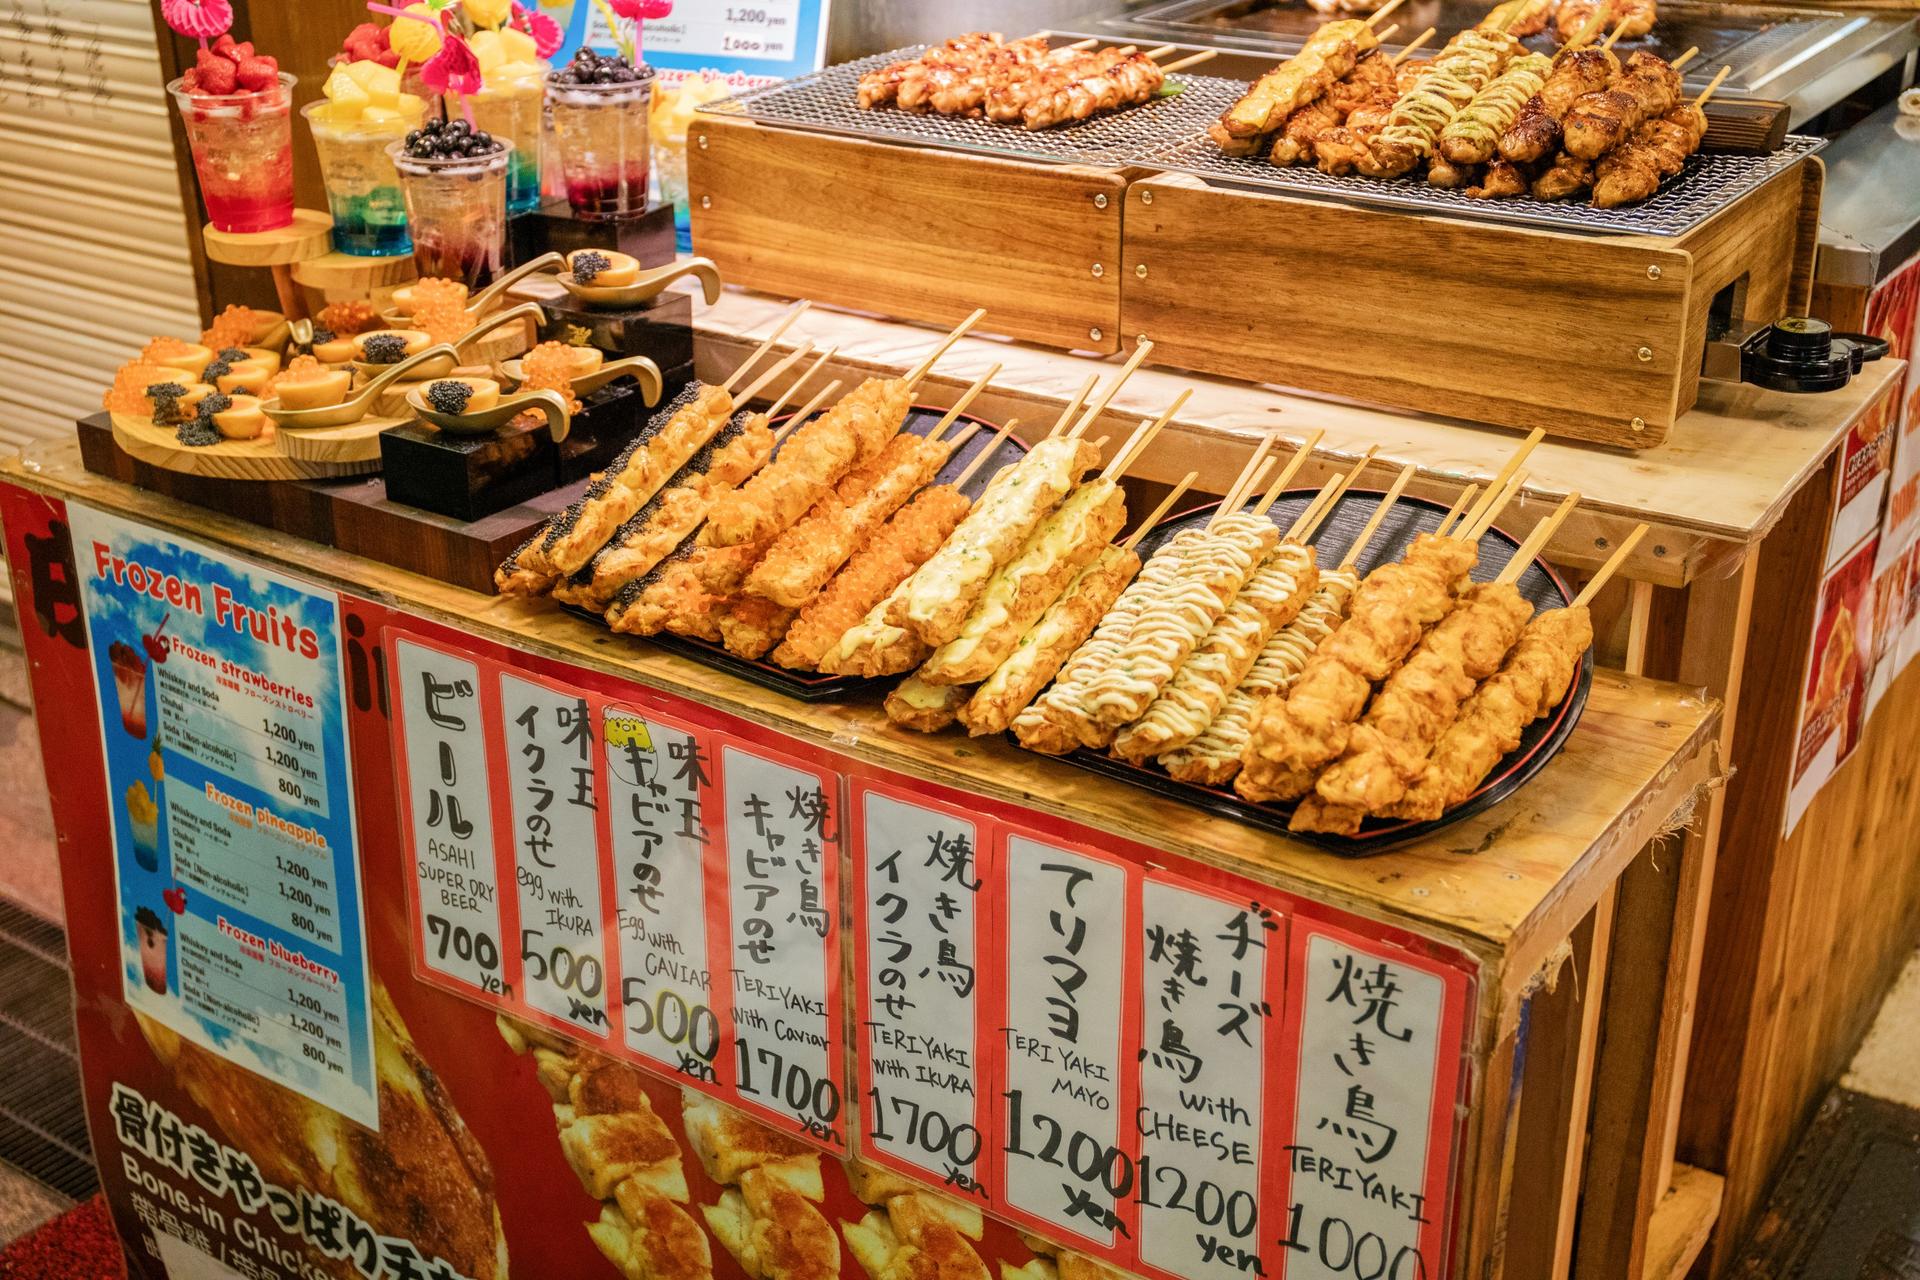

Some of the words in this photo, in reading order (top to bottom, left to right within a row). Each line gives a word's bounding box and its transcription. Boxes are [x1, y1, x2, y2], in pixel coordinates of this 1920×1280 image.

[726, 8, 766, 25] 1,200
[92, 540, 203, 615] Frozen
[214, 585, 320, 660] Fruits
[158, 667, 187, 690] Whiskey
[188, 678, 201, 693] and
[202, 685, 220, 702] Soda
[172, 636, 217, 669] Frozen
[221, 660, 314, 709] strawberries
[163, 721, 180, 738] Soda
[263, 718, 297, 744] 1,200
[298, 736, 315, 753] yen
[422, 671, 474, 840] ビール
[556, 698, 599, 811] 味玉
[265, 746, 299, 773] 1,200
[300, 764, 317, 781] yen
[515, 705, 556, 868] イクラのせ
[668, 736, 711, 845] 味玉
[205, 782, 253, 817] Frozen
[256, 809, 327, 850] pineapple
[278, 778, 302, 800] 800
[303, 792, 320, 809] yen
[428, 838, 475, 870] ASAHI
[624, 737, 670, 915] キャビアのせ
[276, 856, 310, 881] 1,200
[311, 874, 328, 890] yen
[418, 861, 466, 891] SUPER
[470, 878, 494, 903] DRY
[517, 866, 544, 901] egg
[548, 887, 583, 908] with
[738, 793, 787, 966] キャビアのせ
[785, 785, 838, 938] 焼き鳥
[278, 882, 312, 908] 1,200
[314, 902, 331, 917] yen
[291, 912, 315, 934] 800
[316, 928, 333, 943] yen
[441, 889, 482, 913] BEER
[546, 908, 594, 936] IKURA
[616, 908, 645, 942] Egg
[918, 829, 983, 999] 焼き鳥
[218, 917, 265, 951] Frozen
[269, 939, 339, 983] blueberry
[427, 914, 499, 971] 700
[480, 971, 514, 1000] yen
[874, 849, 917, 1020] イクラのせ
[1040, 862, 1094, 1044] てりマヨ
[521, 929, 603, 998] 500
[567, 995, 614, 1029] yen
[644, 952, 713, 992] CAVIAR
[729, 968, 829, 1017] TERIYAKI
[287, 988, 321, 1014] 1,200
[323, 1008, 340, 1023] yen
[290, 1014, 324, 1040] 1,200
[325, 1033, 342, 1048] yen
[622, 977, 720, 1063] 500
[675, 1049, 723, 1087] yen
[1138, 924, 1208, 1084] 焼き鳥
[302, 1042, 326, 1064] 800
[327, 1060, 344, 1075] yen
[774, 1020, 832, 1051] Caviar
[863, 1021, 971, 1069] TERIYAKI
[1316, 954, 1413, 1164] 焼き鳥
[733, 1036, 841, 1125] 1700
[797, 1112, 846, 1148] yen
[915, 1065, 975, 1098] IKURA
[1051, 1076, 1110, 1111] MAYO
[1179, 1089, 1252, 1127] with
[867, 1086, 982, 1168] 1700
[942, 1161, 990, 1200] yen
[1002, 1089, 1134, 1200] 1200
[1135, 1106, 1255, 1165] CHEESE
[1063, 1182, 1132, 1240] yen
[1283, 1145, 1431, 1224] TERIYAKI
[120, 1150, 227, 1235] Bone-in
[233, 1217, 337, 1280] Chicke
[1133, 1155, 1257, 1238] 1200
[1196, 1234, 1268, 1279] yen
